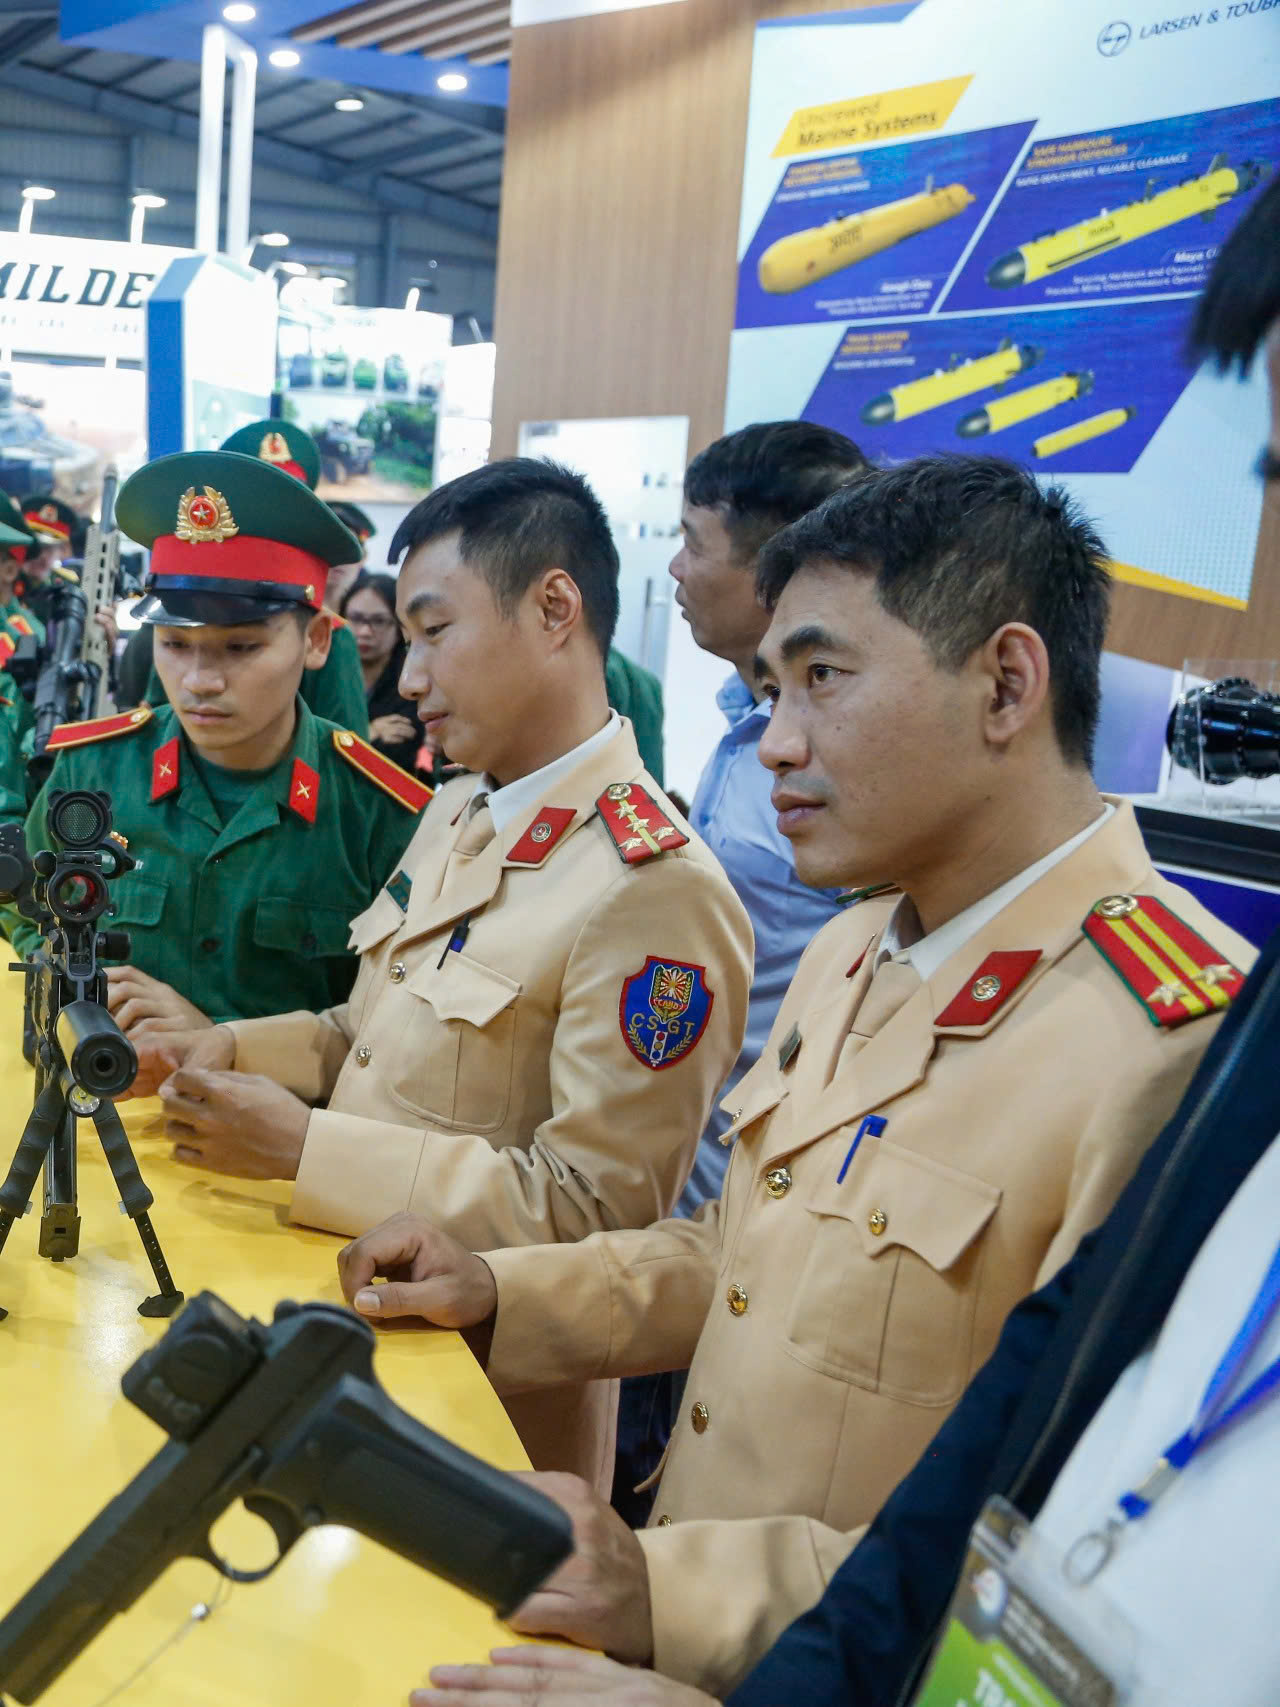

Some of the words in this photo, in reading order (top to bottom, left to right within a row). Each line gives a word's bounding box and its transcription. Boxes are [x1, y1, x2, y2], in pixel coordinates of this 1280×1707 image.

[1138, 13, 1203, 39] LARSEN
[1206, 9, 1220, 24] &
[799, 127, 858, 147] Marine
[863, 110, 938, 139] Systems
